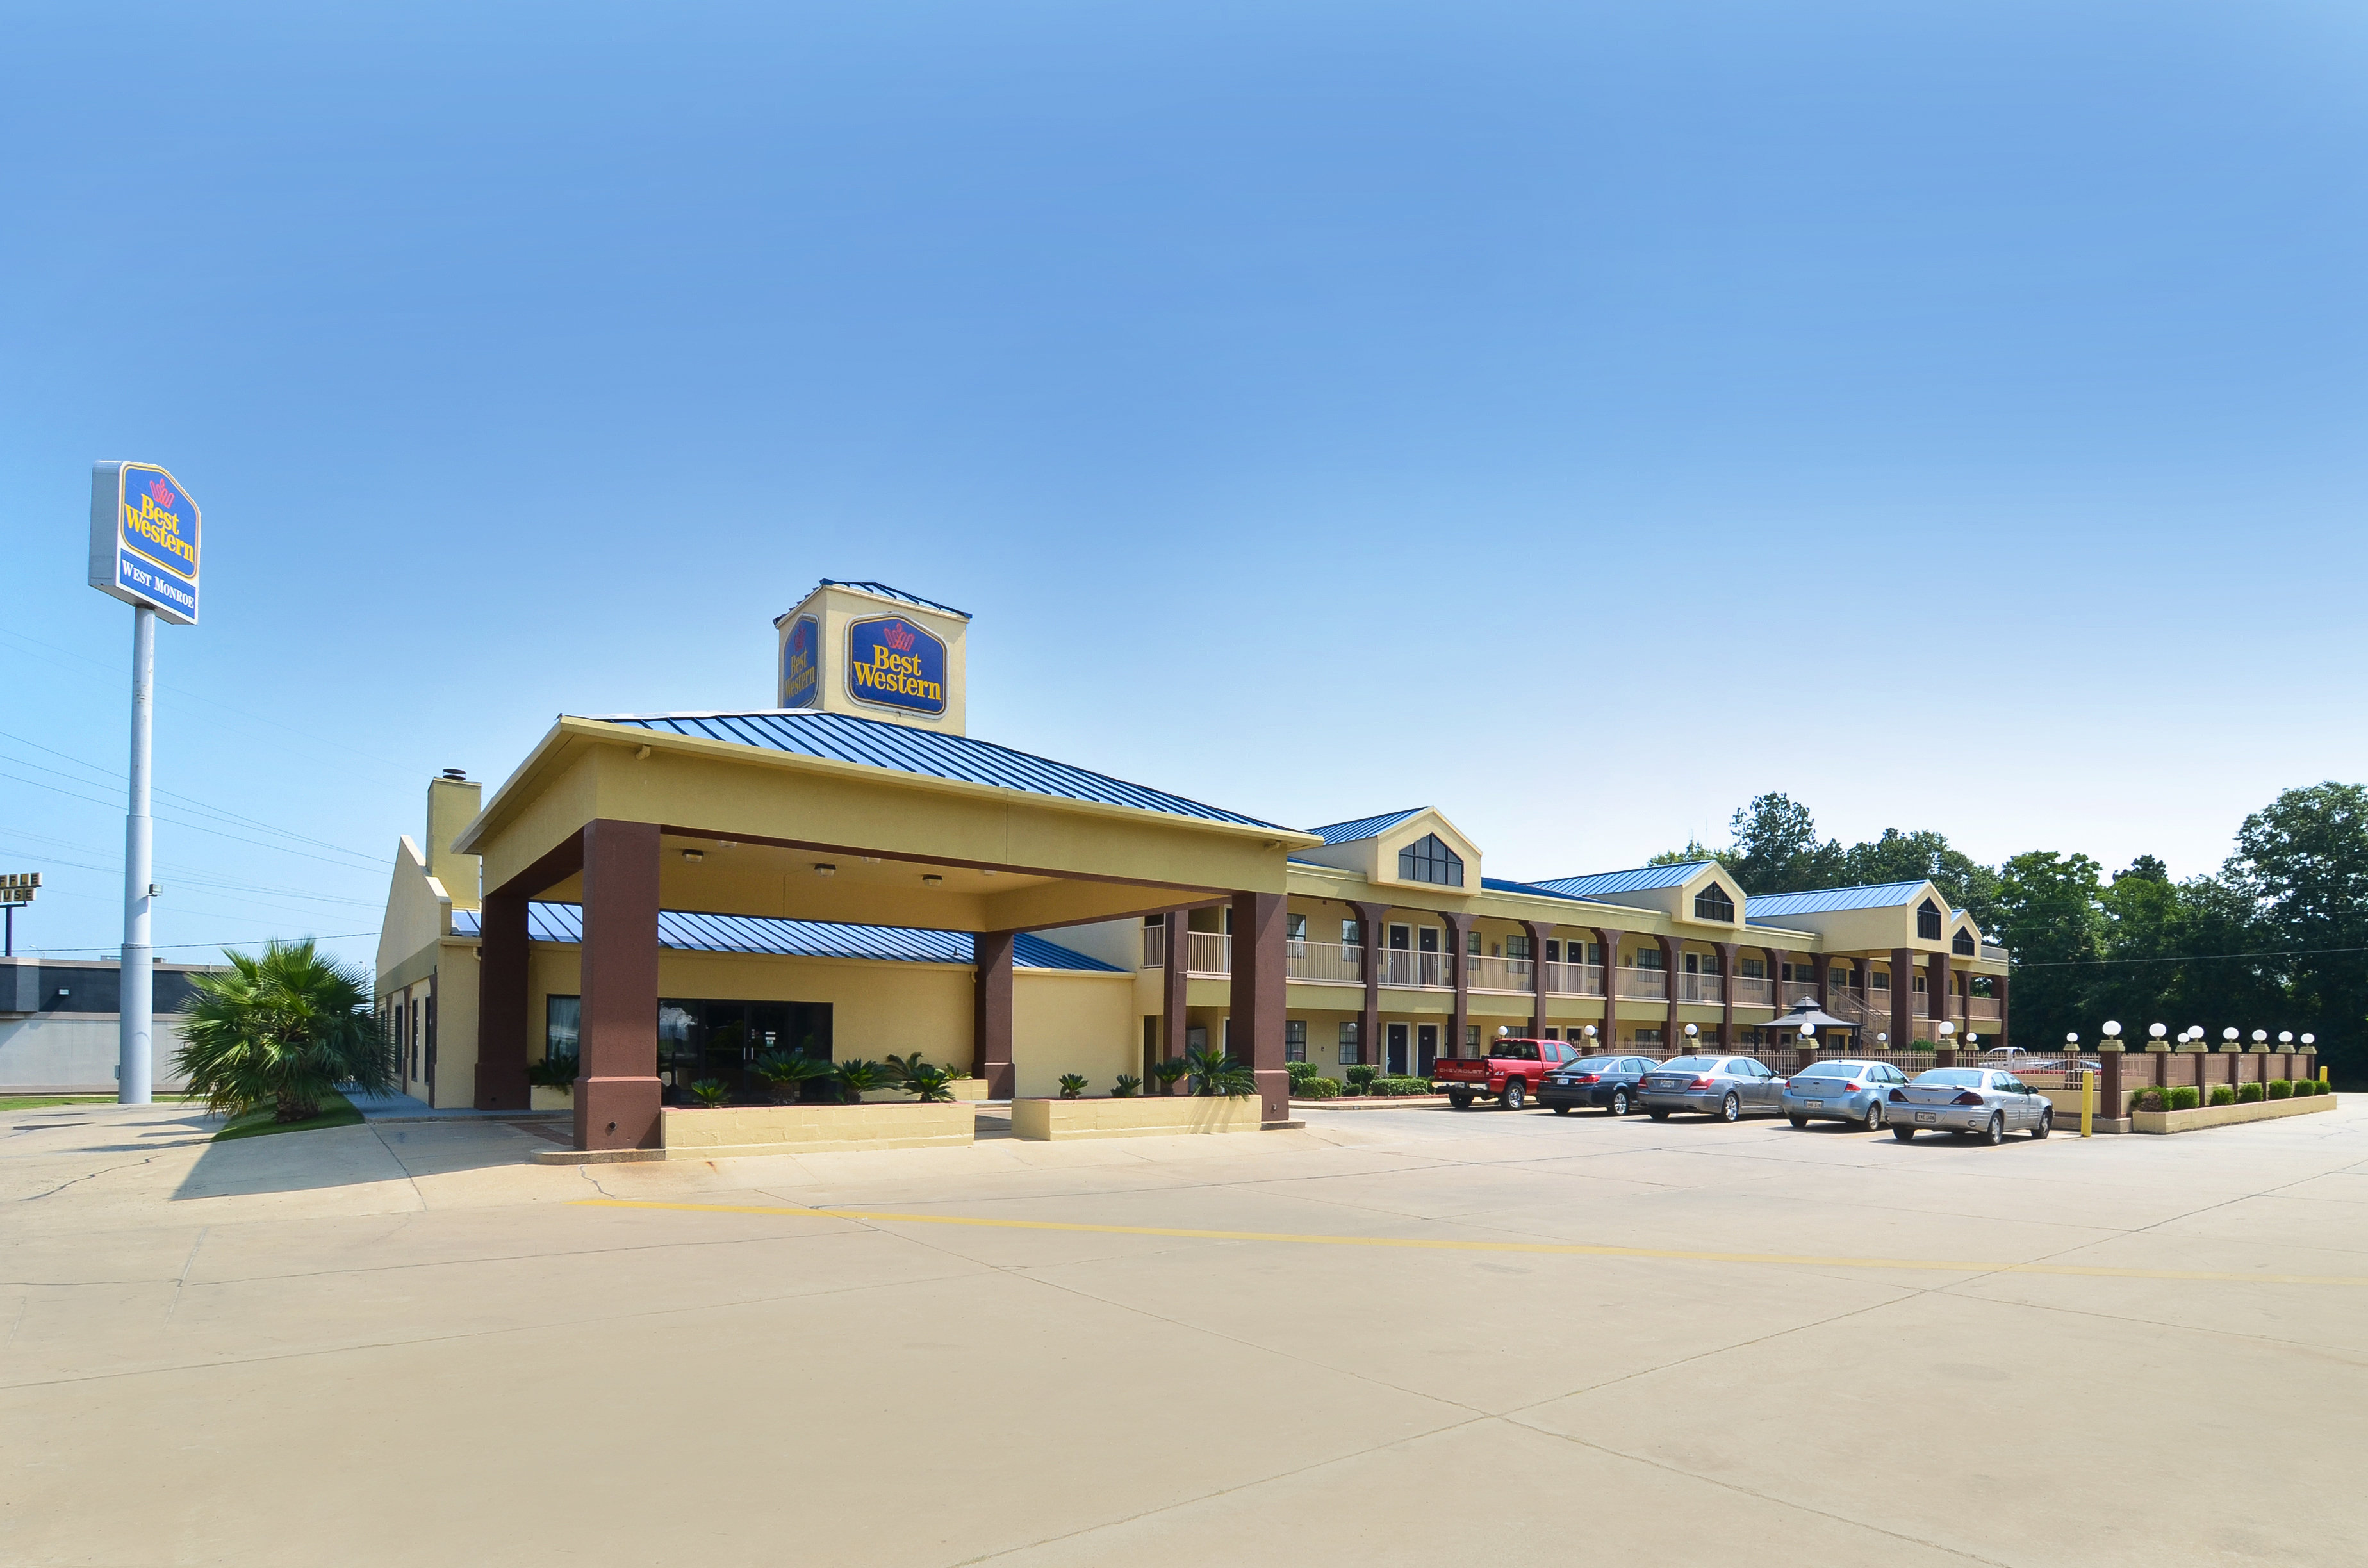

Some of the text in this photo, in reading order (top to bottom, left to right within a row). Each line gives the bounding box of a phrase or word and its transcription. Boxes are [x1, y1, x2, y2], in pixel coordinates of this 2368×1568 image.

[124, 503, 194, 563] Western
[141, 493, 179, 534] Best
[121, 559, 194, 609] WEST MONROE
[791, 646, 807, 678] Best
[853, 660, 942, 701] Western
[873, 644, 921, 676] Best
[785, 666, 815, 700] Western
